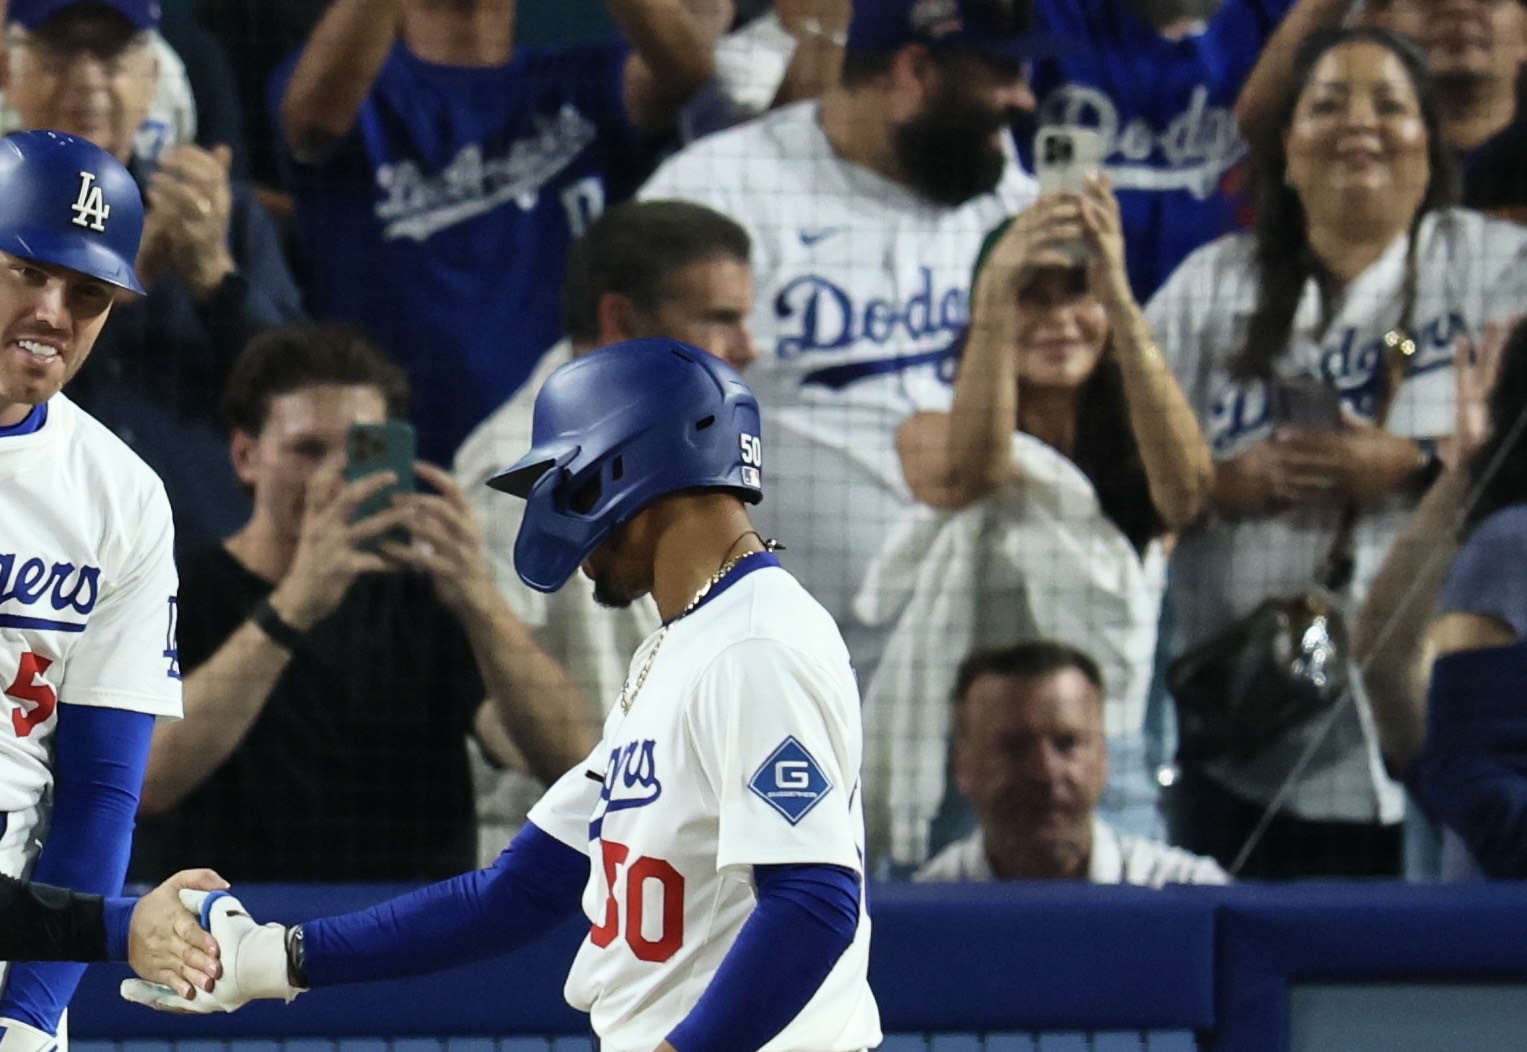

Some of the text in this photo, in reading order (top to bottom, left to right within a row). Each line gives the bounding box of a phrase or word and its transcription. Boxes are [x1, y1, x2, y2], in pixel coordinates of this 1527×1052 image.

[72, 171, 110, 232] LA
[740, 433, 762, 467] 50
[3, 651, 57, 738] 5
